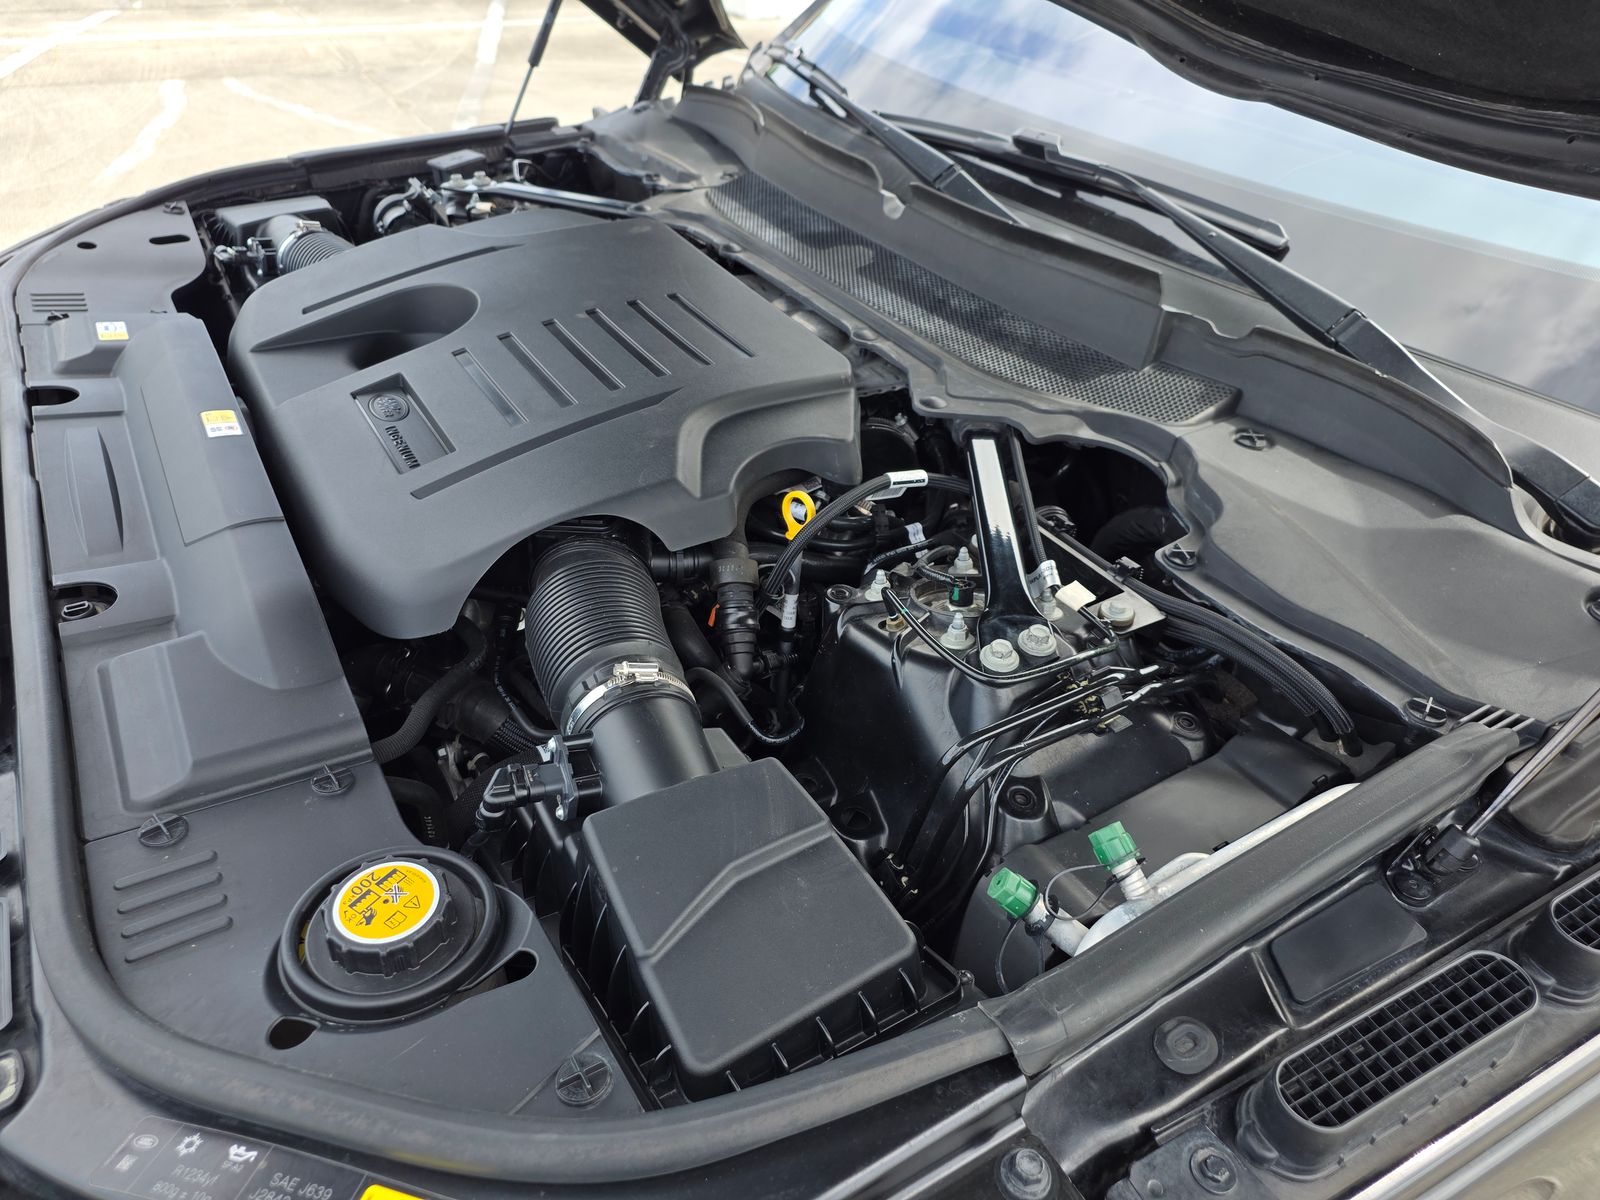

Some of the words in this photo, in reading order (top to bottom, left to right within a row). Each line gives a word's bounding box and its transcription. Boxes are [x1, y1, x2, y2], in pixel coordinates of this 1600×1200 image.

[385, 425, 421, 469] INGENIUM
[351, 872, 380, 895] 200
[269, 1172, 301, 1192] SAE
[299, 1182, 333, 1200] J639
